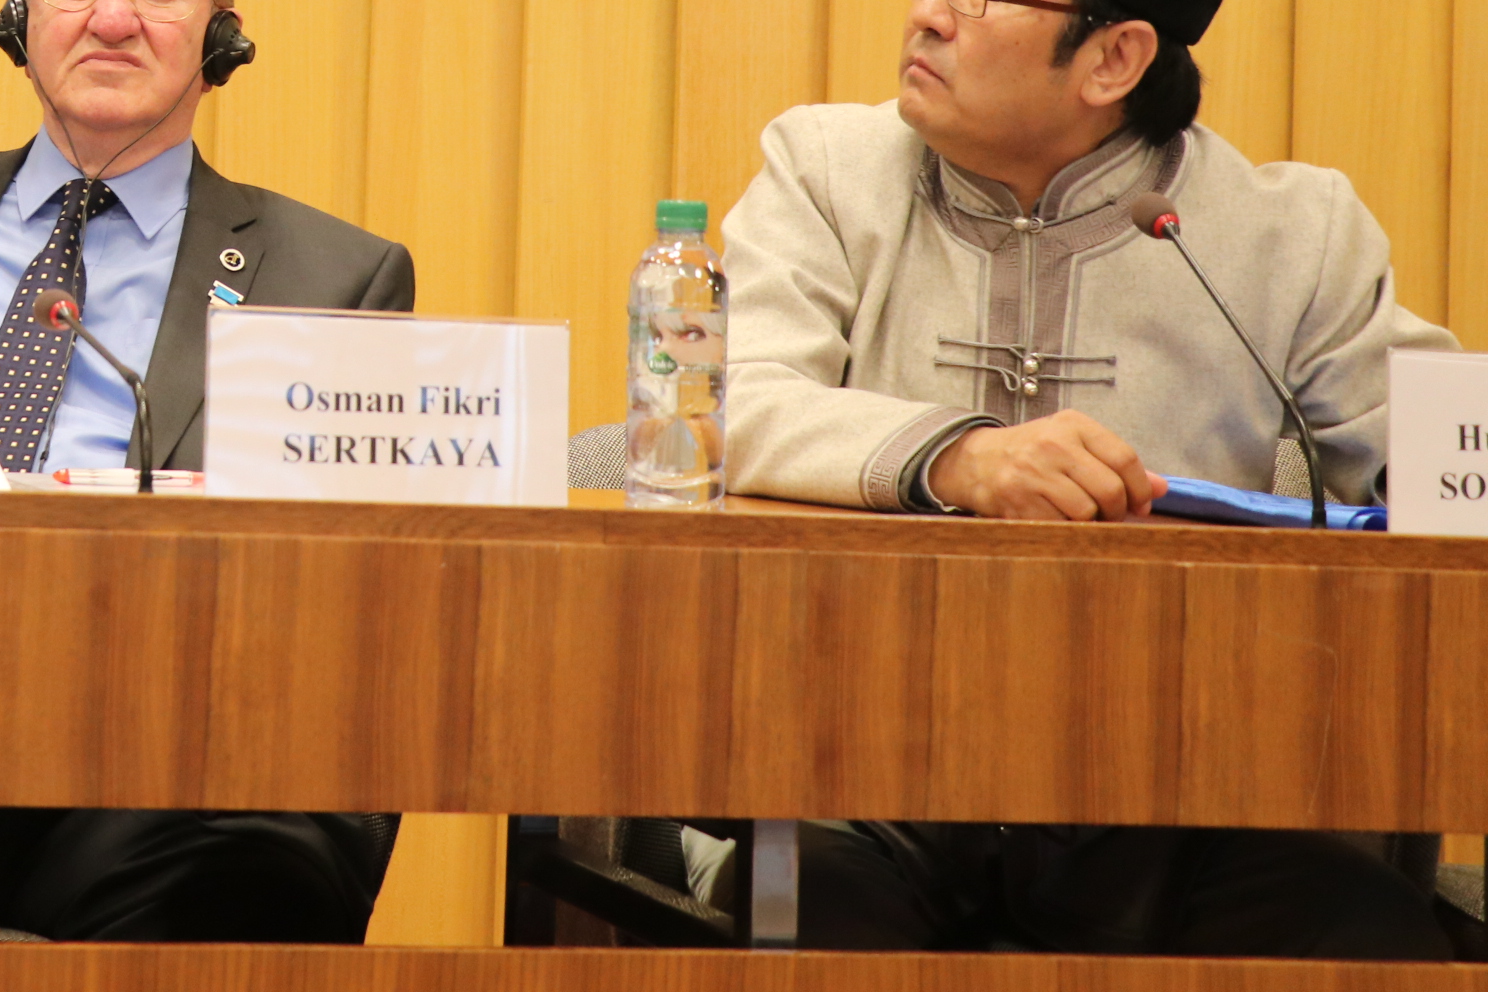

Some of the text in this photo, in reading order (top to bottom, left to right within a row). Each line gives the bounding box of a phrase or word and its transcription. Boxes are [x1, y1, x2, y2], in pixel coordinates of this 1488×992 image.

[286, 381, 502, 417] Osman Fikri
[282, 433, 502, 468] SERTKAYA
[1458, 424, 1488, 451] H
